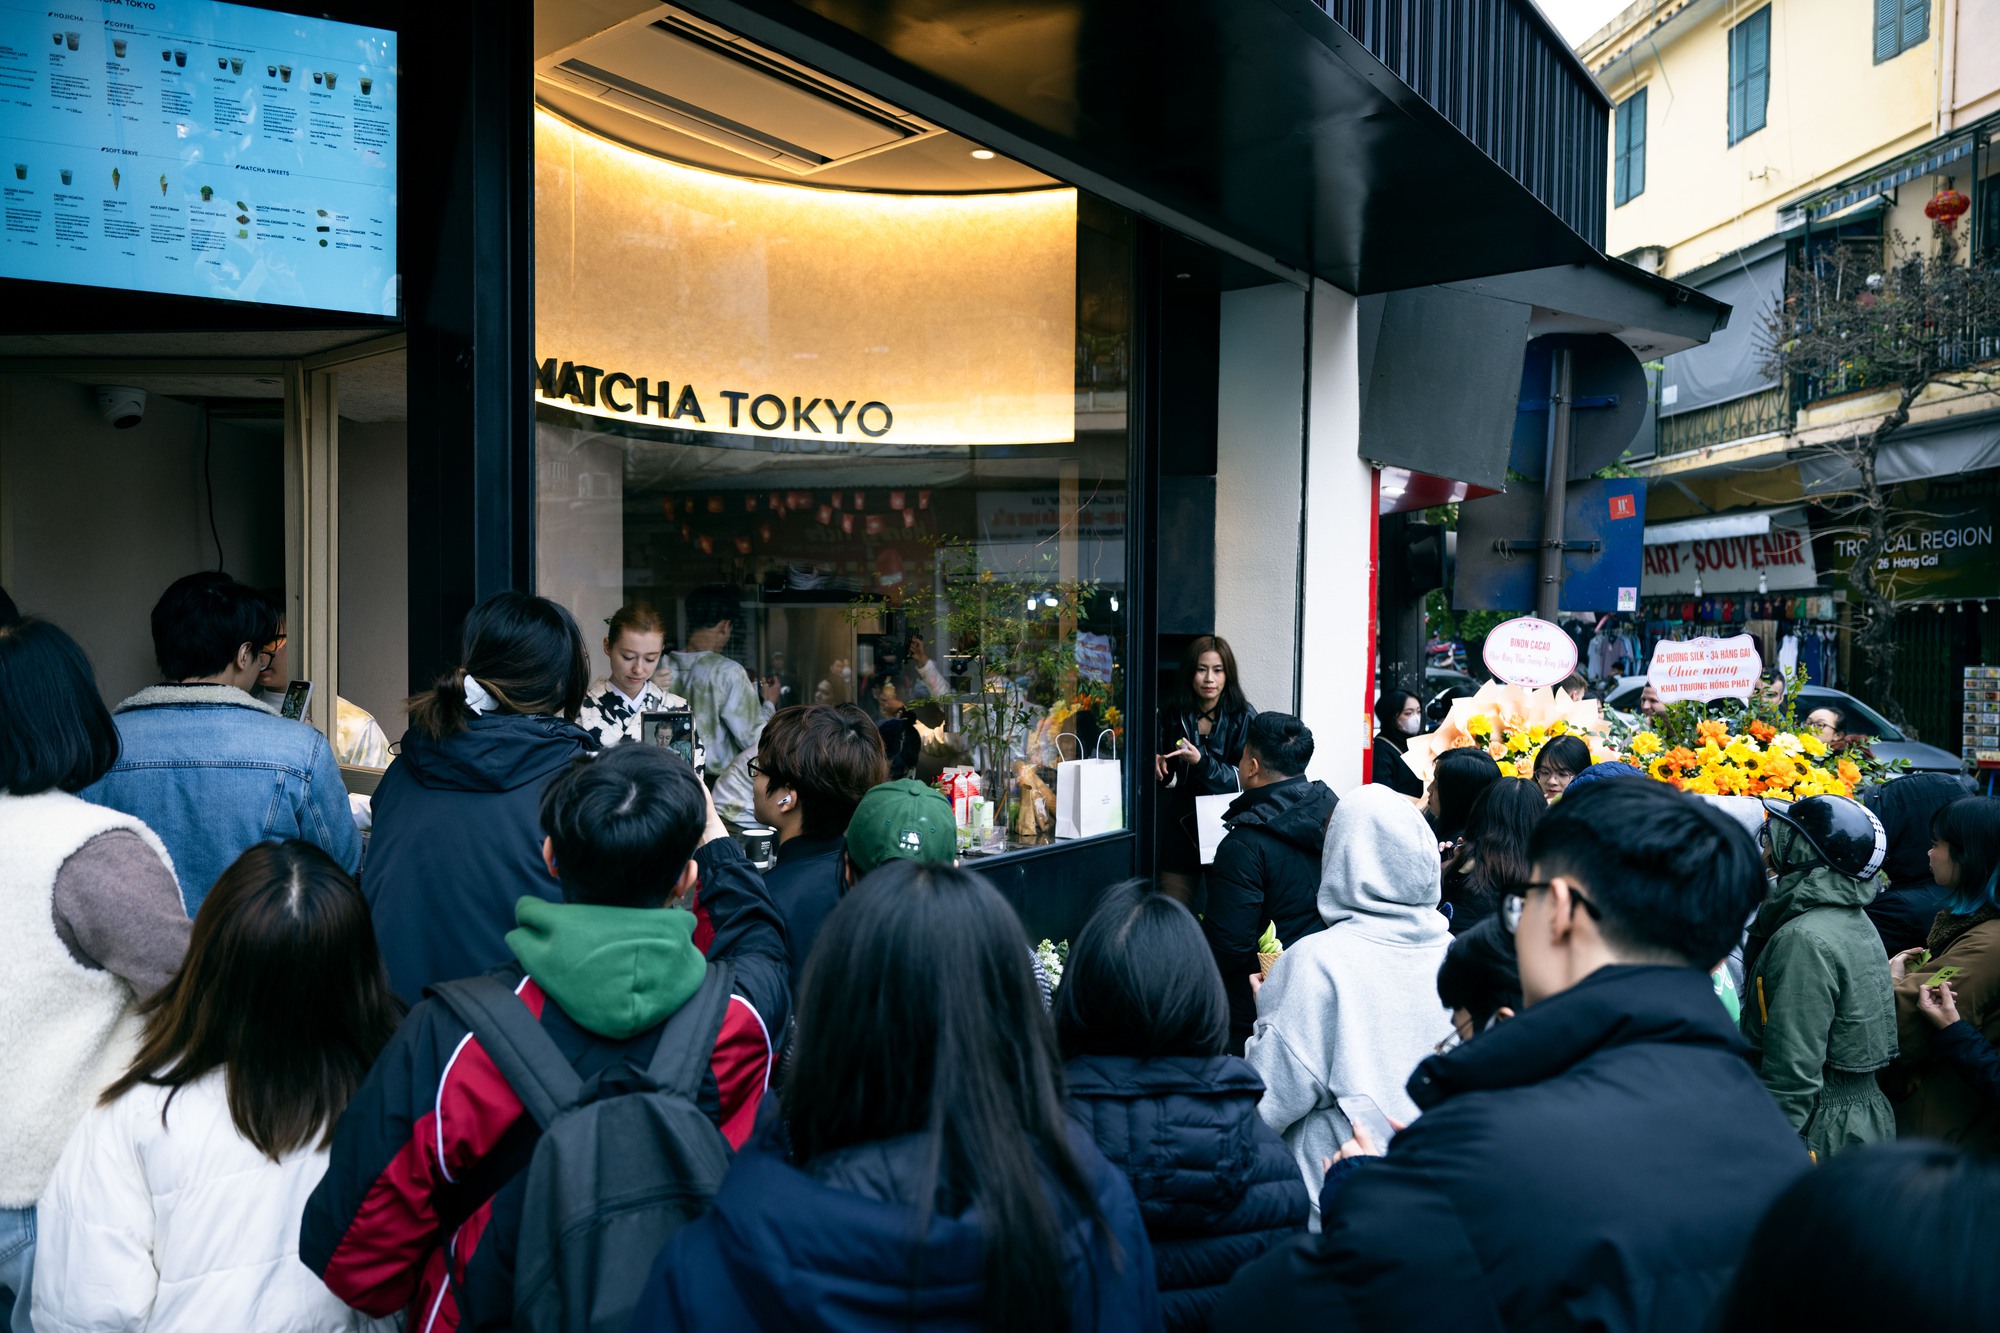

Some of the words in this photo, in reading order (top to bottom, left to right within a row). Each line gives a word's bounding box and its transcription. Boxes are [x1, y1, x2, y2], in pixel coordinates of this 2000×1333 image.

[54, 12, 84, 22] HOJICHA
[109, 21, 135, 29] COFFEE
[240, 165, 265, 173] MATCHA
[267, 168, 289, 176] SWEETS
[719, 389, 893, 438] TOKYO
[1921, 526, 1992, 550] REGION
[1877, 558, 1889, 569] 26
[1893, 556, 1919, 569] Hàng
[1921, 553, 1938, 566] Gai
[1530, 640, 1551, 652] CACAO
[1656, 653, 1665, 664] AC
[1690, 650, 1704, 662] SILK
[1710, 650, 1719, 660] 34
[1740, 648, 1751, 658] GAI
[1668, 664, 1699, 678] Chúc
[1660, 684, 1678, 693] KHAI
